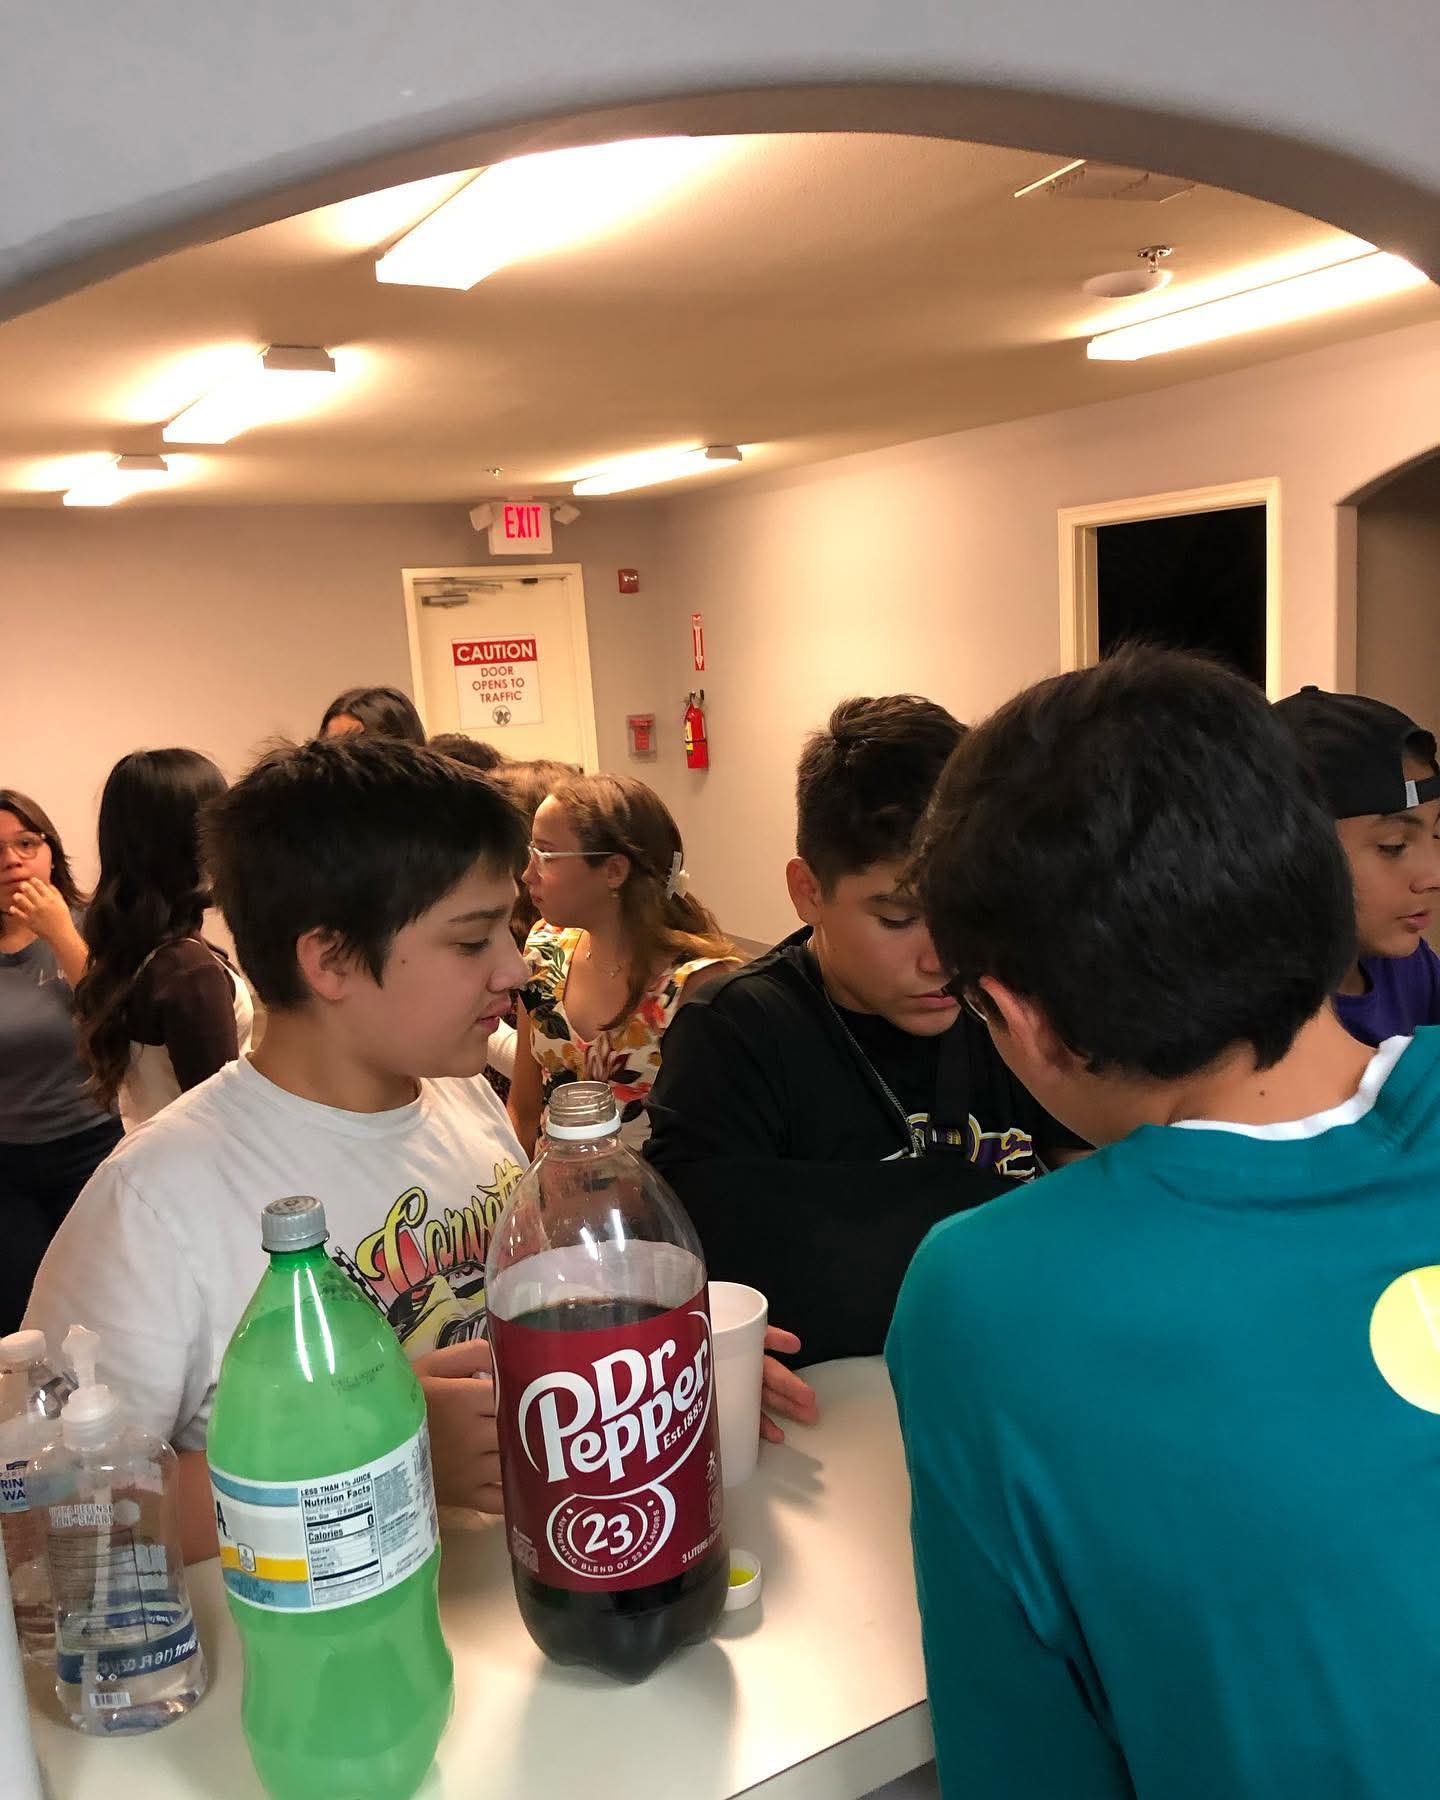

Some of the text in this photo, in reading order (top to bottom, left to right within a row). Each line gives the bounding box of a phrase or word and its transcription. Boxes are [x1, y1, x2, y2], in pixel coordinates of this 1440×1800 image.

[504, 505, 541, 539] EXIT
[456, 642, 534, 663] CAUTION
[472, 678, 525, 691] OPENS TO
[480, 666, 514, 677] DOOR
[480, 691, 522, 704] TRAFFIC
[355, 1158, 524, 1296] Corvett
[591, 1339, 676, 1422] Dr
[518, 1338, 708, 1483] Pepper
[301, 1487, 318, 1496] LESS
[320, 1483, 339, 1493] THAN
[352, 1472, 371, 1485] JUICE
[304, 1485, 371, 1508] Nutrition Facts
[308, 1513, 374, 1542] Calories 0
[582, 1513, 633, 1555] 23
[556, 1517, 577, 1565] AUTHENTIC
[580, 1563, 614, 1573] BLEND
[617, 1559, 629, 1570] OF
[643, 1509, 660, 1551] FLAVORS
[682, 1553, 688, 1564] 3
